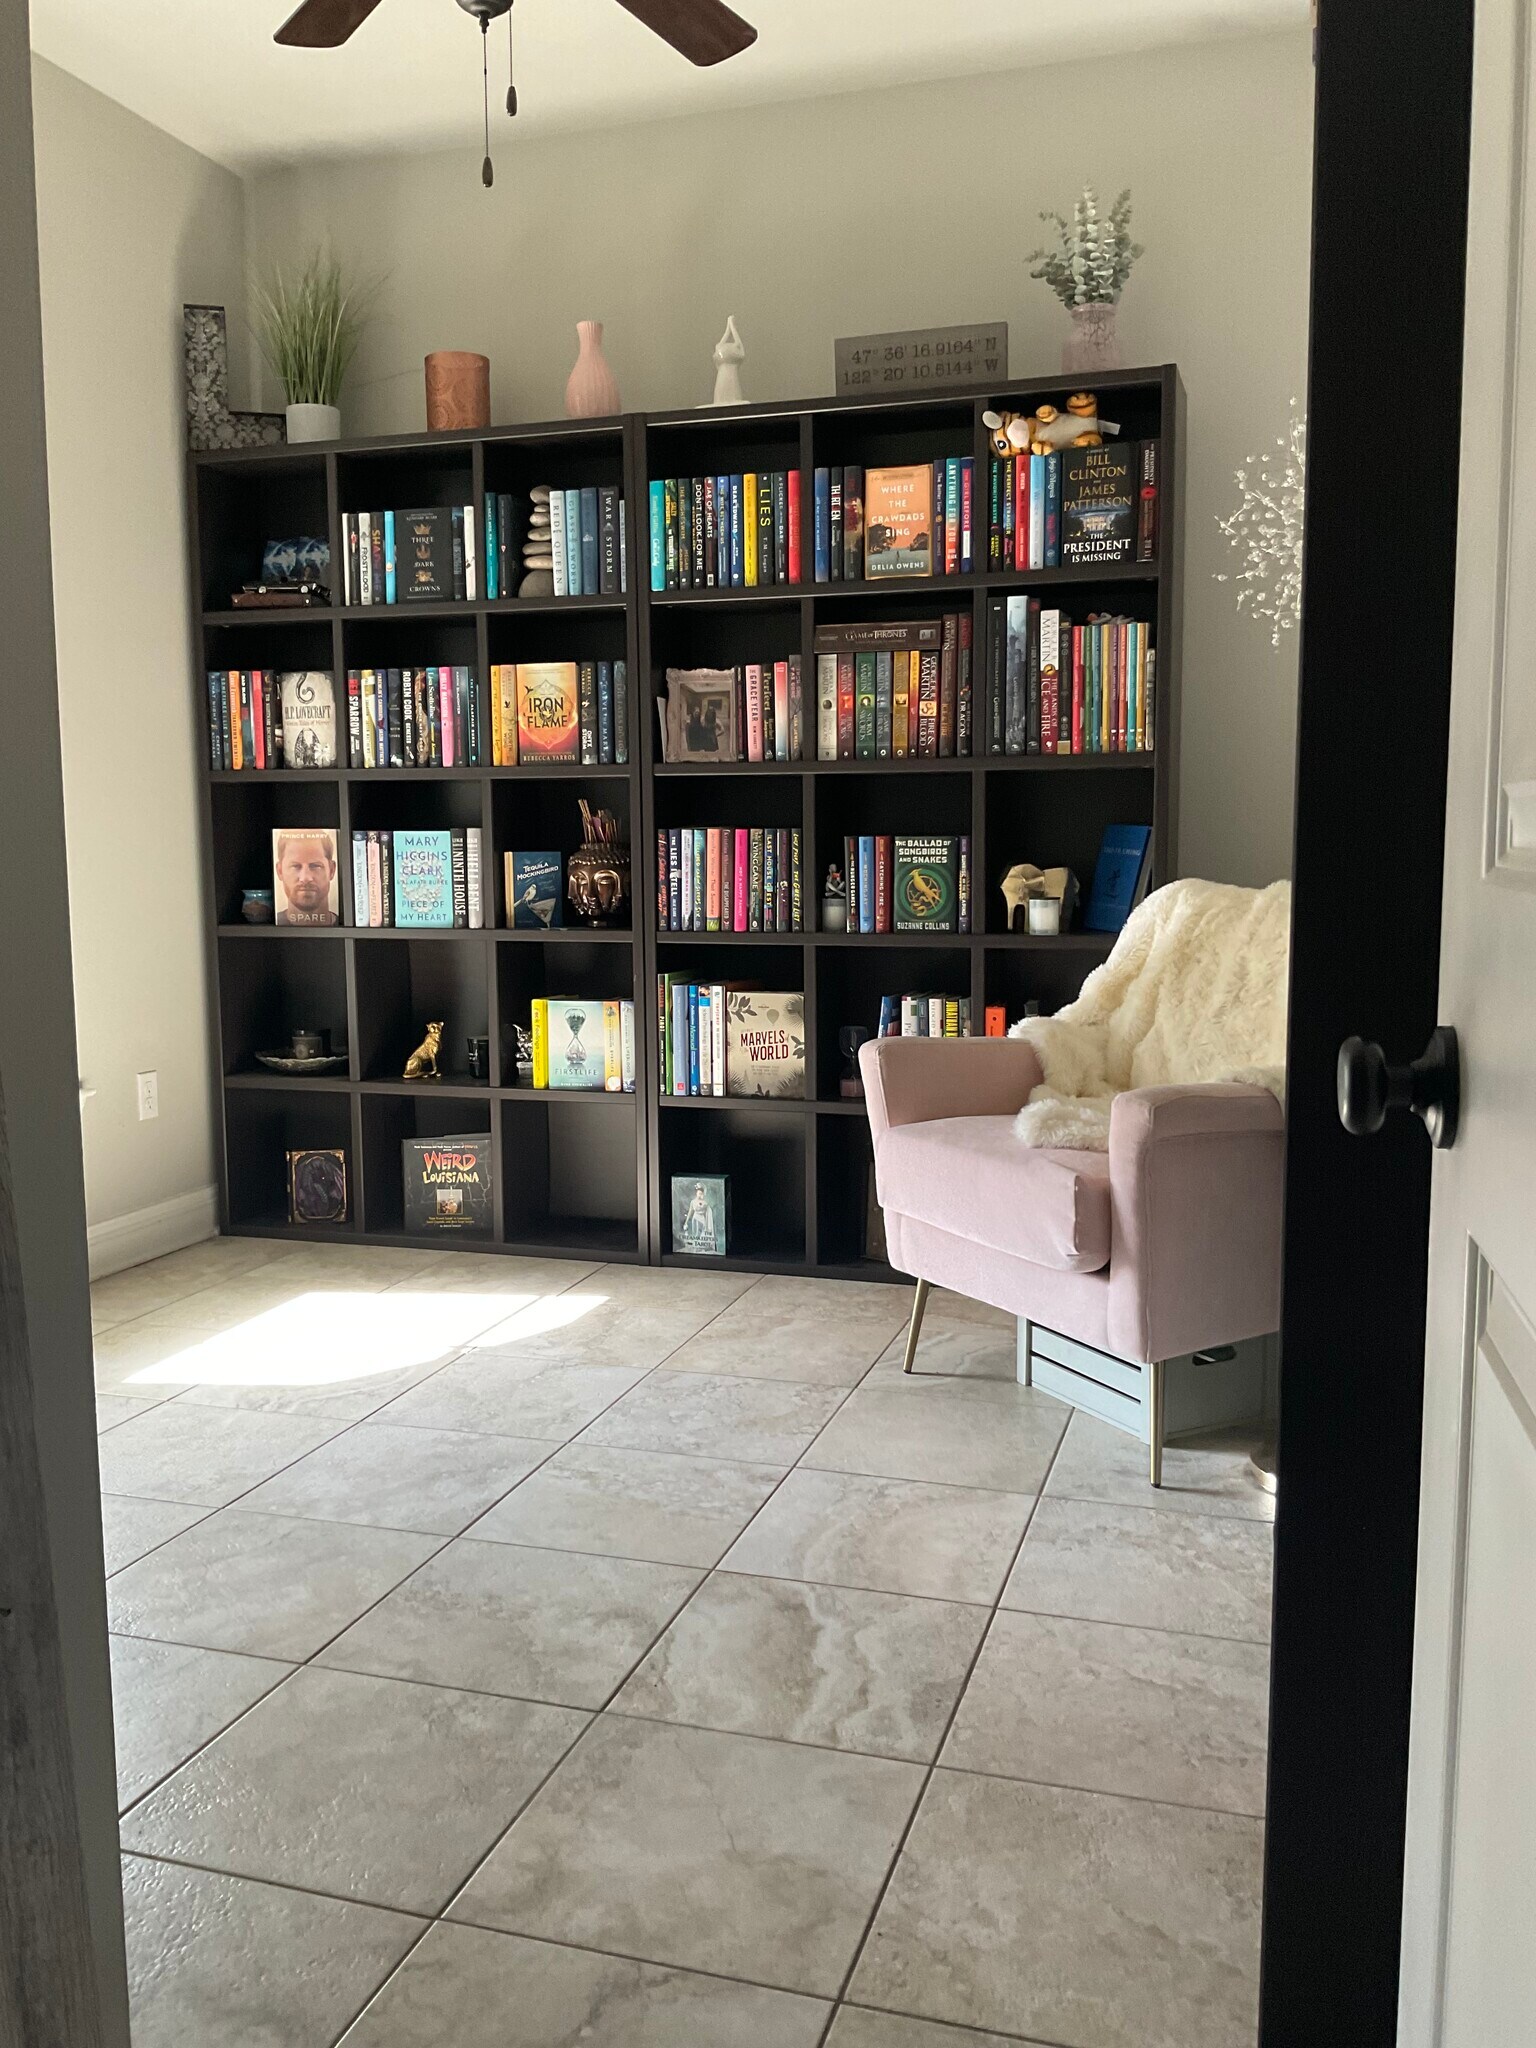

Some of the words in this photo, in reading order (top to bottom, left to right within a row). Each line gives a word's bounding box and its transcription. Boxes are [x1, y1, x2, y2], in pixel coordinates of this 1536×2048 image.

[985, 337, 997, 350] N
[985, 358, 998, 372] W
[1086, 454, 1110, 466] BILL
[1069, 466, 1126, 480] CLINTON
[880, 484, 915, 494] WHERE
[948, 464, 956, 505] ANYTHING
[1080, 483, 1116, 498] JAMES
[605, 497, 613, 520] WAR
[706, 500, 712, 511] OF
[760, 489, 771, 527] LIES
[888, 499, 907, 508] THE
[1063, 496, 1132, 511] PATTERSON
[552, 504, 561, 528] RED
[568, 500, 576, 533] GLASS
[871, 512, 925, 524] CRAWDADS
[948, 508, 956, 524] FOR
[411, 536, 434, 544] THREE
[885, 528, 910, 537] SING
[948, 528, 957, 543] YOU
[1063, 539, 1131, 554] PRESIDENT
[554, 541, 563, 584] QUEEN
[606, 536, 614, 574] STORM
[1071, 555, 1080, 563] IS
[1081, 552, 1121, 562] MISSING
[361, 547, 369, 593] FROSTBLOOD
[697, 558, 703, 571] ME
[871, 563, 894, 571] DELIA
[896, 561, 924, 570] OWENS
[845, 630, 868, 640] GAME
[873, 629, 908, 639] THRONES
[1042, 618, 1051, 662] MARTIN
[402, 671, 411, 698] ROBIN
[921, 657, 930, 701] MARTIN
[750, 674, 758, 700] GRACE
[763, 672, 771, 711] Perfect
[1041, 678, 1051, 696] ICE
[404, 699, 412, 721] COOK
[429, 686, 437, 719] Scottoline
[529, 697, 563, 713] IRON
[296, 705, 330, 719] LOVECRAFT
[349, 695, 359, 736] SPARROW
[527, 715, 568, 729] FLAME
[1041, 715, 1051, 737] FIRE
[1052, 717, 1058, 728] OF
[928, 735, 935, 745] &
[405, 836, 439, 846] MARY
[907, 839, 943, 847] BALLAD
[396, 851, 448, 861] HIGGINS
[670, 847, 678, 866] LIES
[402, 866, 442, 875] CLARK
[453, 851, 464, 881] NINTH
[467, 854, 478, 881] HELL
[516, 865, 559, 880] MOCKINGBIRD
[523, 862, 549, 873] TEQUILA
[432, 900, 445, 908] OF
[454, 885, 466, 916] HOUSE
[469, 884, 479, 912] BENT
[289, 913, 326, 922] SPARE
[417, 913, 447, 921] HEART
[897, 922, 923, 930] SUZANNE
[924, 922, 950, 930] COLLINS
[689, 1025, 698, 1051] Manual
[740, 1030, 785, 1047] MARVELS
[749, 1044, 789, 1061] WORLD
[423, 1150, 477, 1173] WEIRD
[422, 1171, 480, 1184] LOUISIANA
